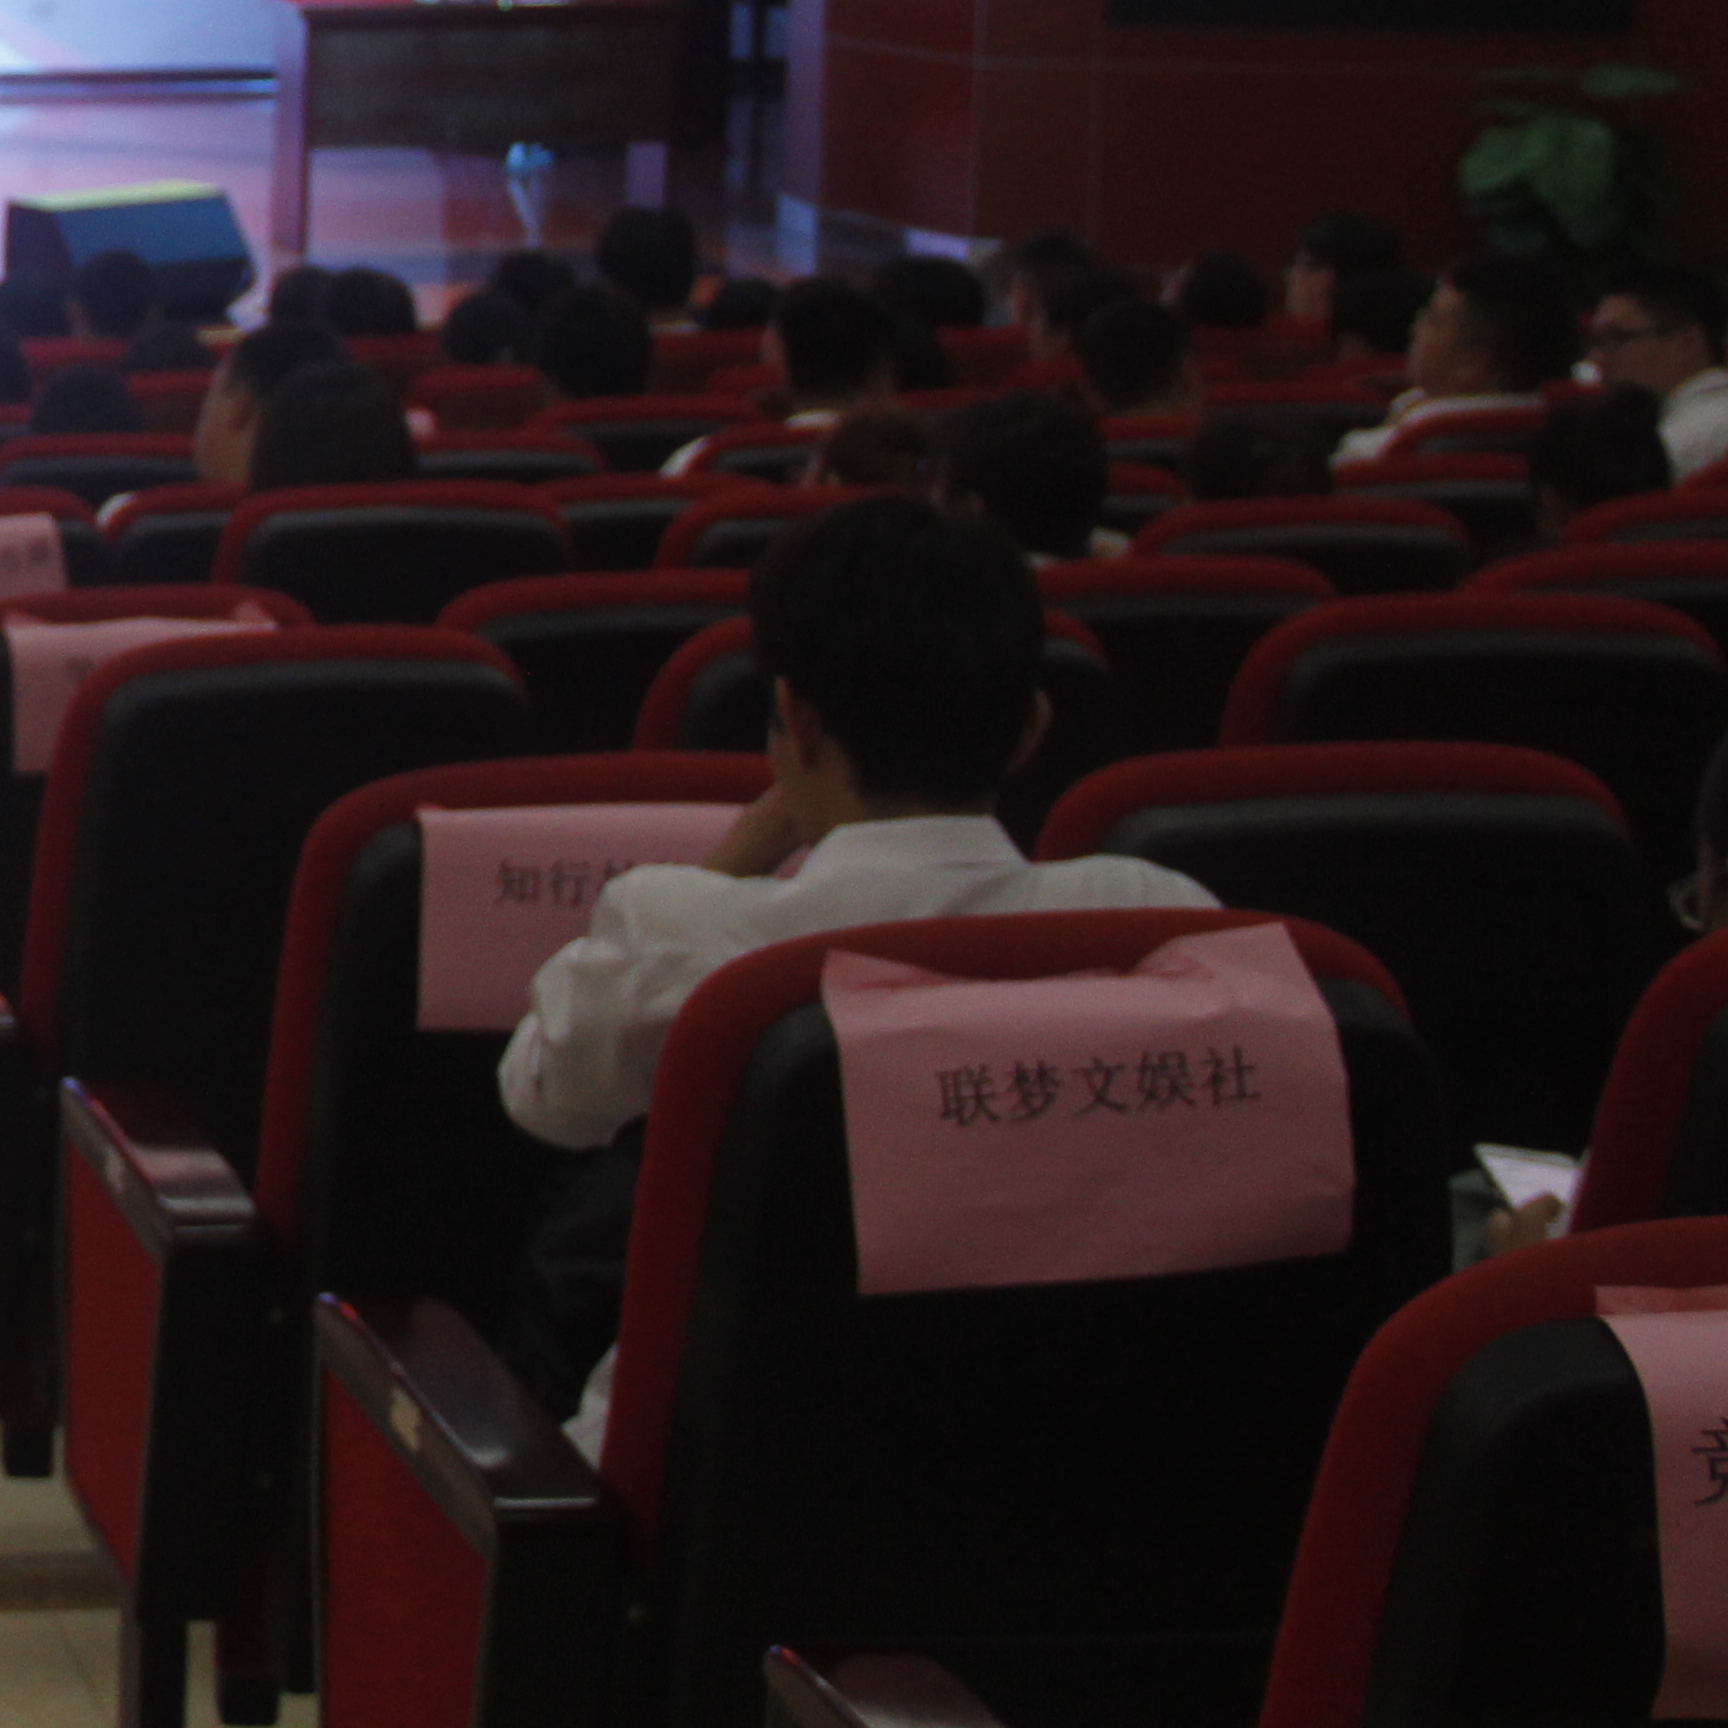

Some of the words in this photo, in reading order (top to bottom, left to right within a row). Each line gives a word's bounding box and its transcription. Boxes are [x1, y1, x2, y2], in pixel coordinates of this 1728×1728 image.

[937, 1046, 1262, 1128] 联梦文娱社
